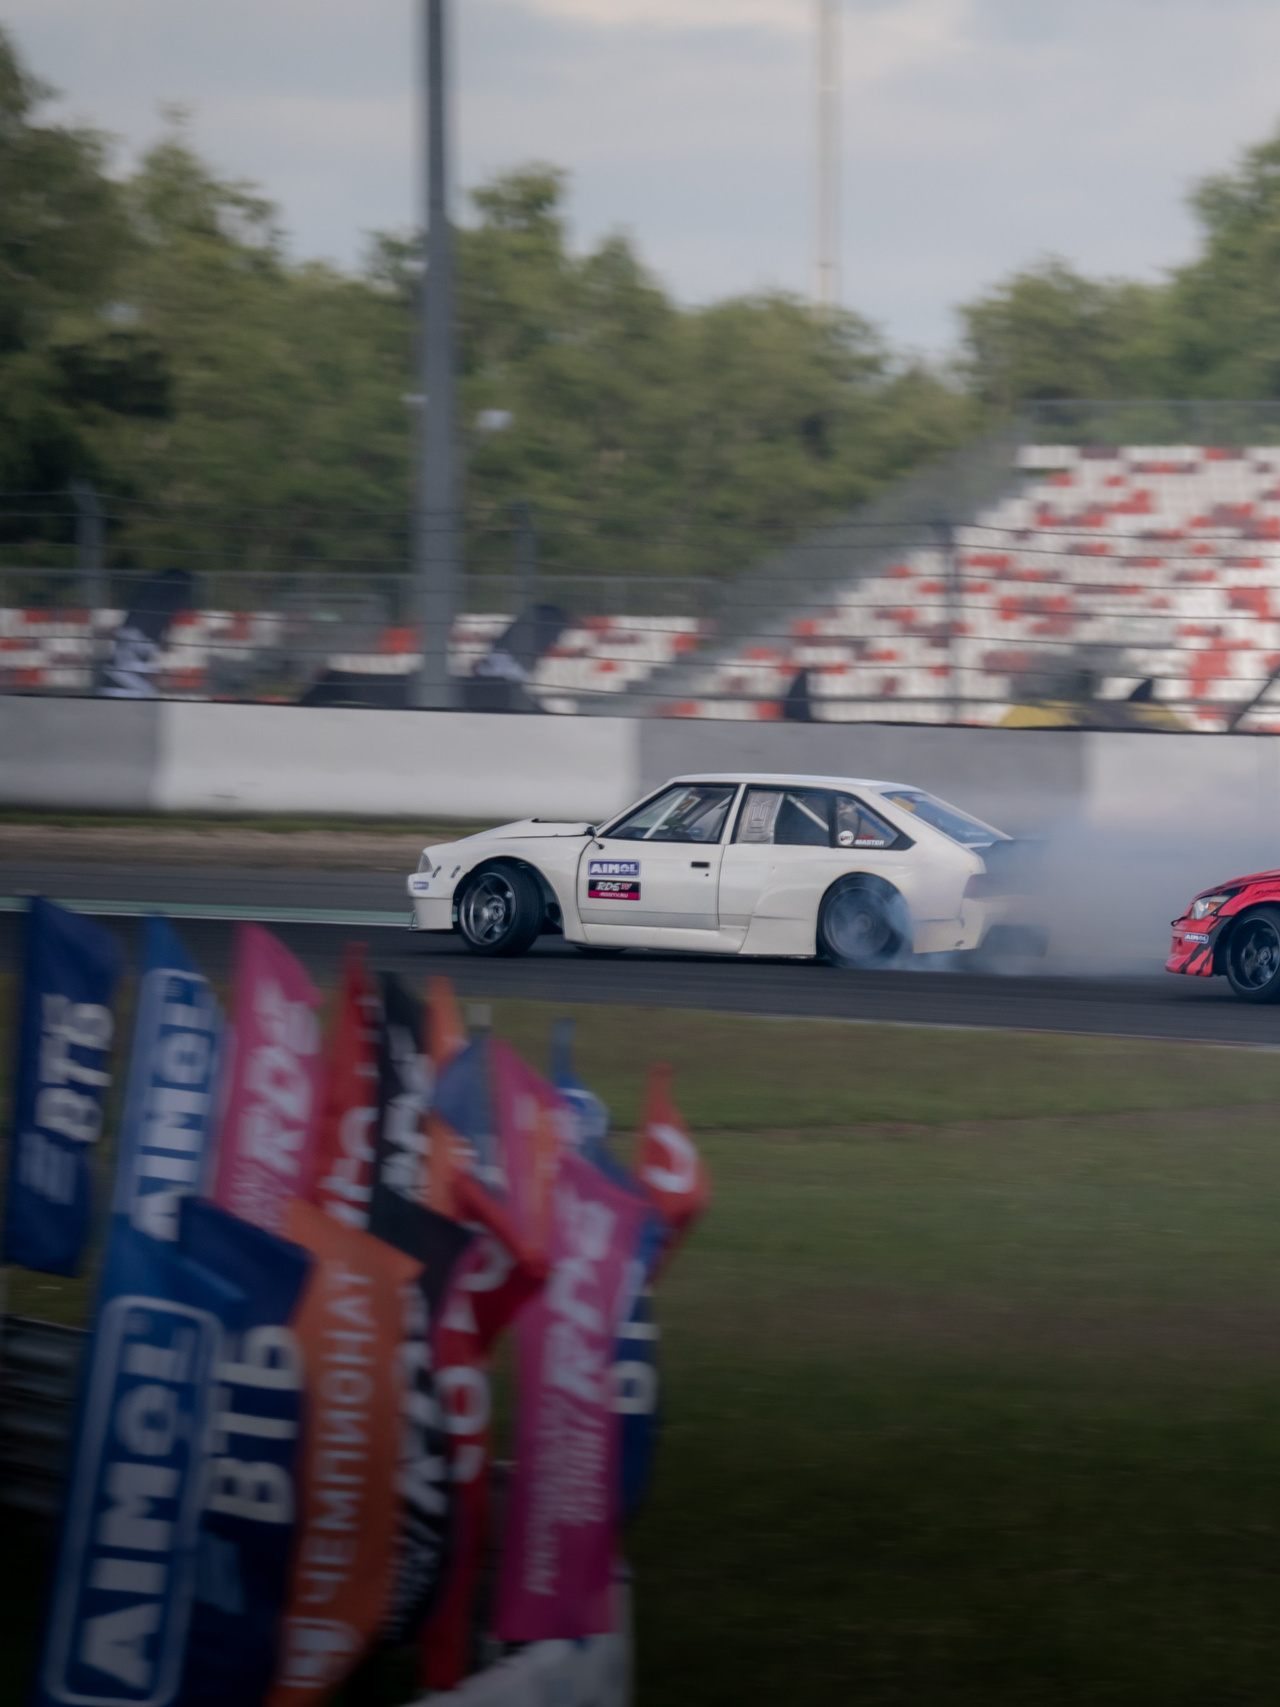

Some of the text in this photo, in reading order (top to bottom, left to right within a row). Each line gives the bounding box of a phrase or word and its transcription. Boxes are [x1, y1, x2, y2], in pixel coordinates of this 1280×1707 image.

[590, 863, 638, 874] AIMOL
[595, 881, 621, 892] RDS
[34, 992, 115, 1144] ВТБ
[127, 990, 215, 1242] AIMOL
[79, 1326, 194, 1690] AIMOL
[202, 1323, 305, 1524] ВТБ
[296, 1258, 378, 1604] ЧЕМПИОНАТ
